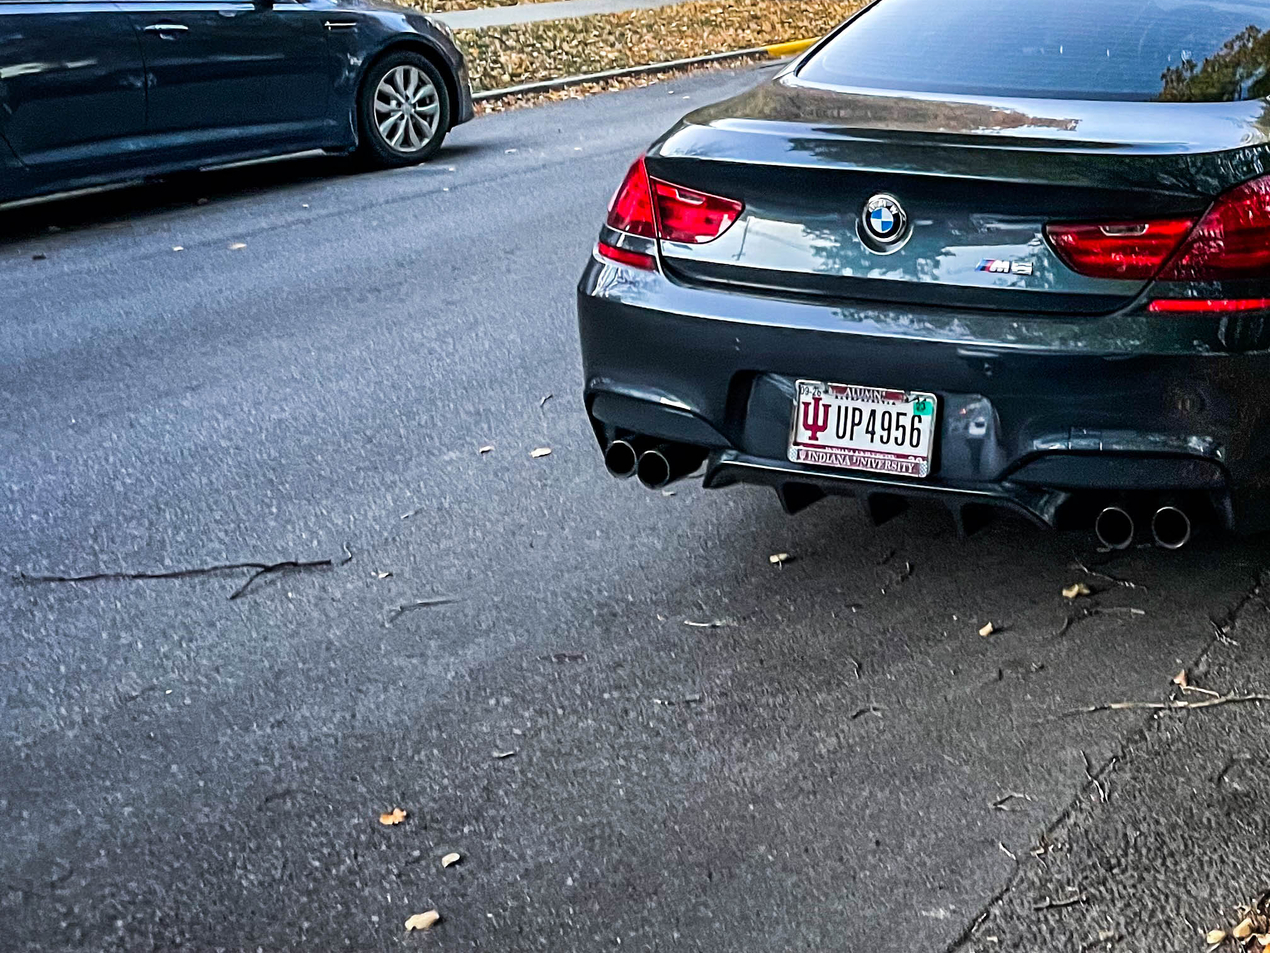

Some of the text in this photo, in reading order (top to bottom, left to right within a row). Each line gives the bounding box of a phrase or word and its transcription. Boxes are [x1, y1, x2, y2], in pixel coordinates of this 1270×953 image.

[835, 405, 922, 448] UP4956
[807, 451, 851, 466] INDIANA
[852, 456, 915, 473] UNIVERSITY
